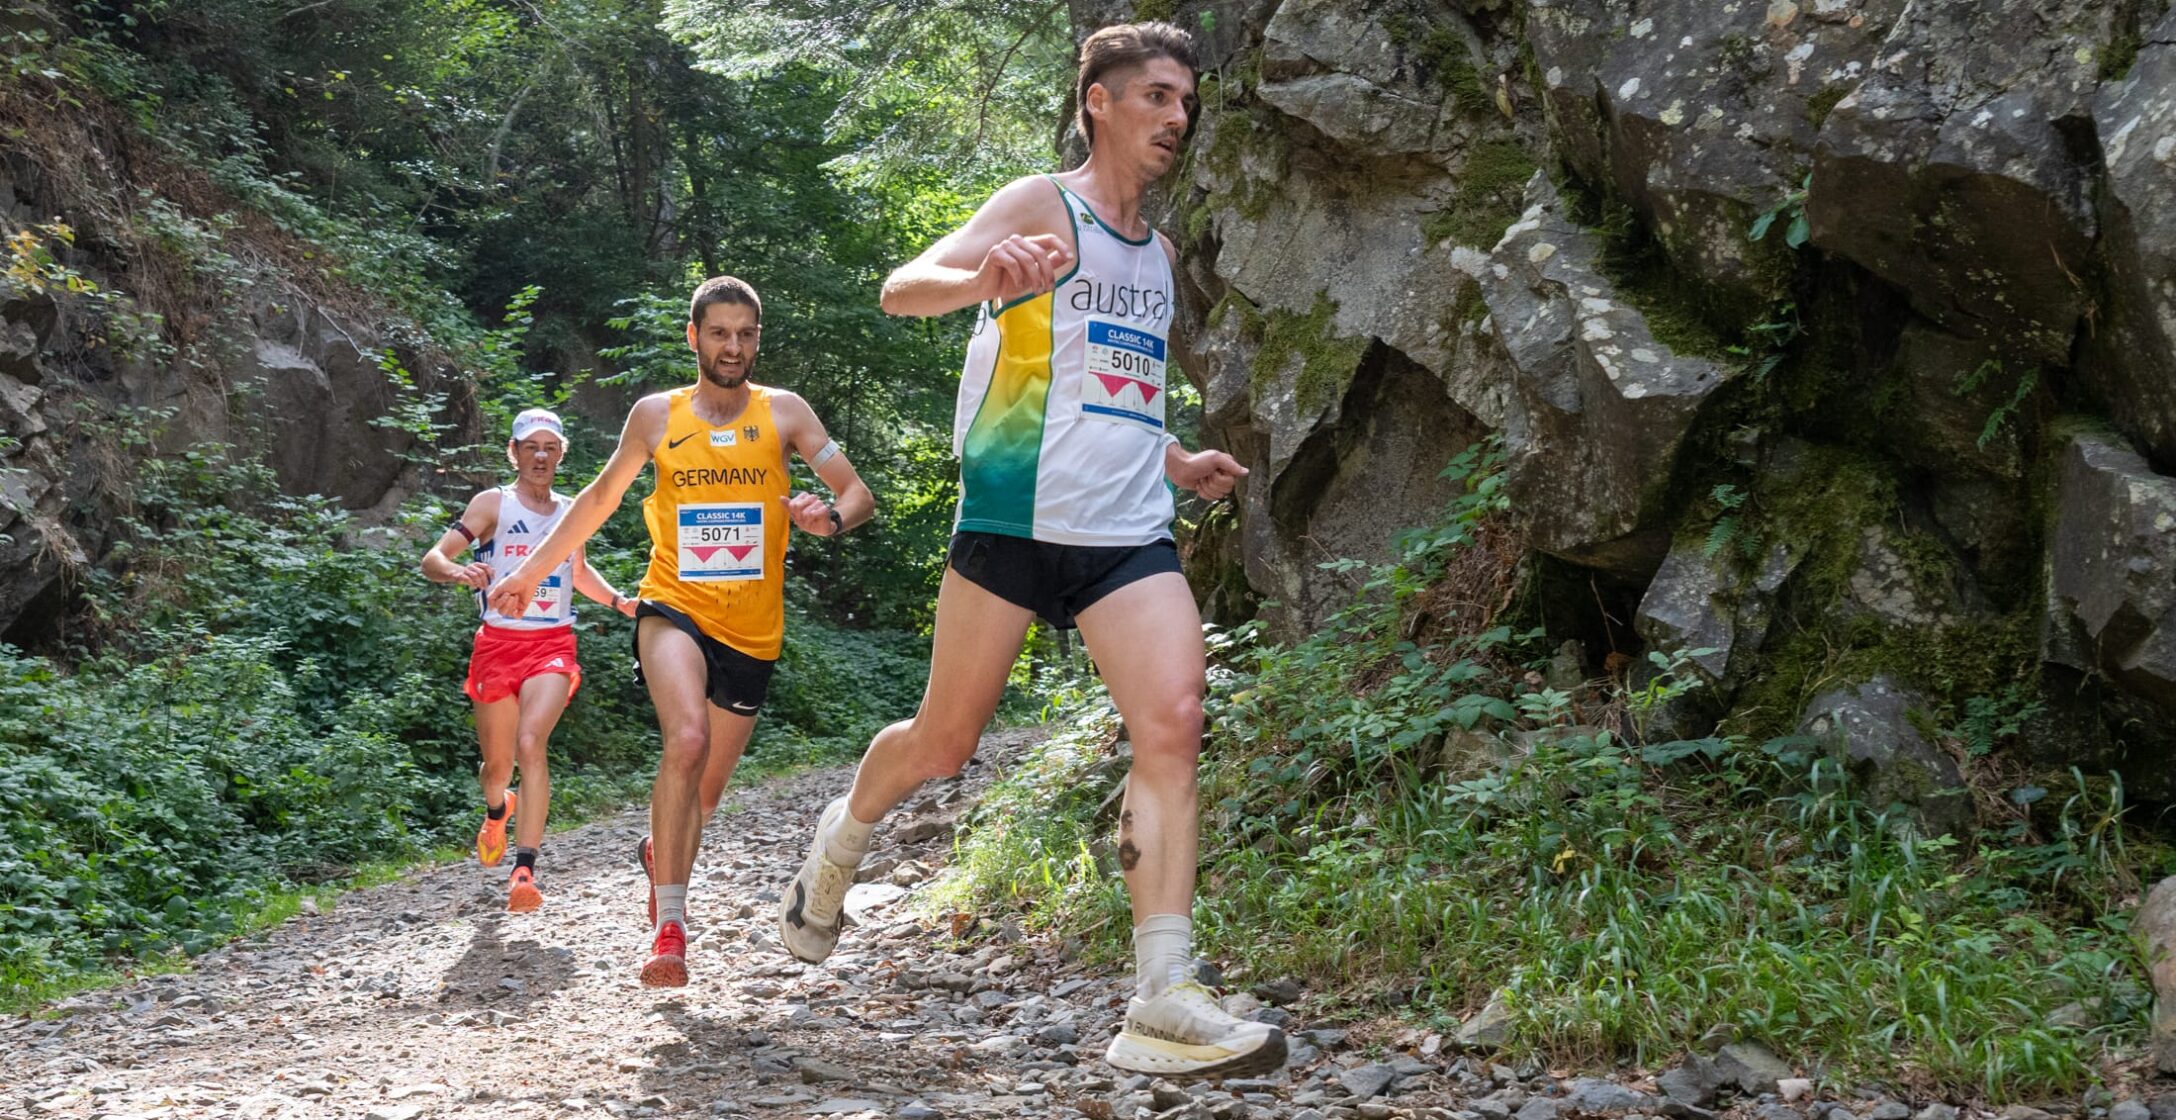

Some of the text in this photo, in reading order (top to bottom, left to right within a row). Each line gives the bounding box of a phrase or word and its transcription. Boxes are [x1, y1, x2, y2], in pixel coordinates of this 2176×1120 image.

[1108, 329, 1142, 345] CLASSIC
[1142, 337, 1154, 350] 14K
[1111, 350, 1150, 376] 5010
[711, 432, 735, 443] WGV
[672, 468, 768, 488] GERMANY
[696, 511, 746, 520] CLASSIC 14K
[701, 527, 740, 542] 5071
[533, 588, 547, 598] 59
